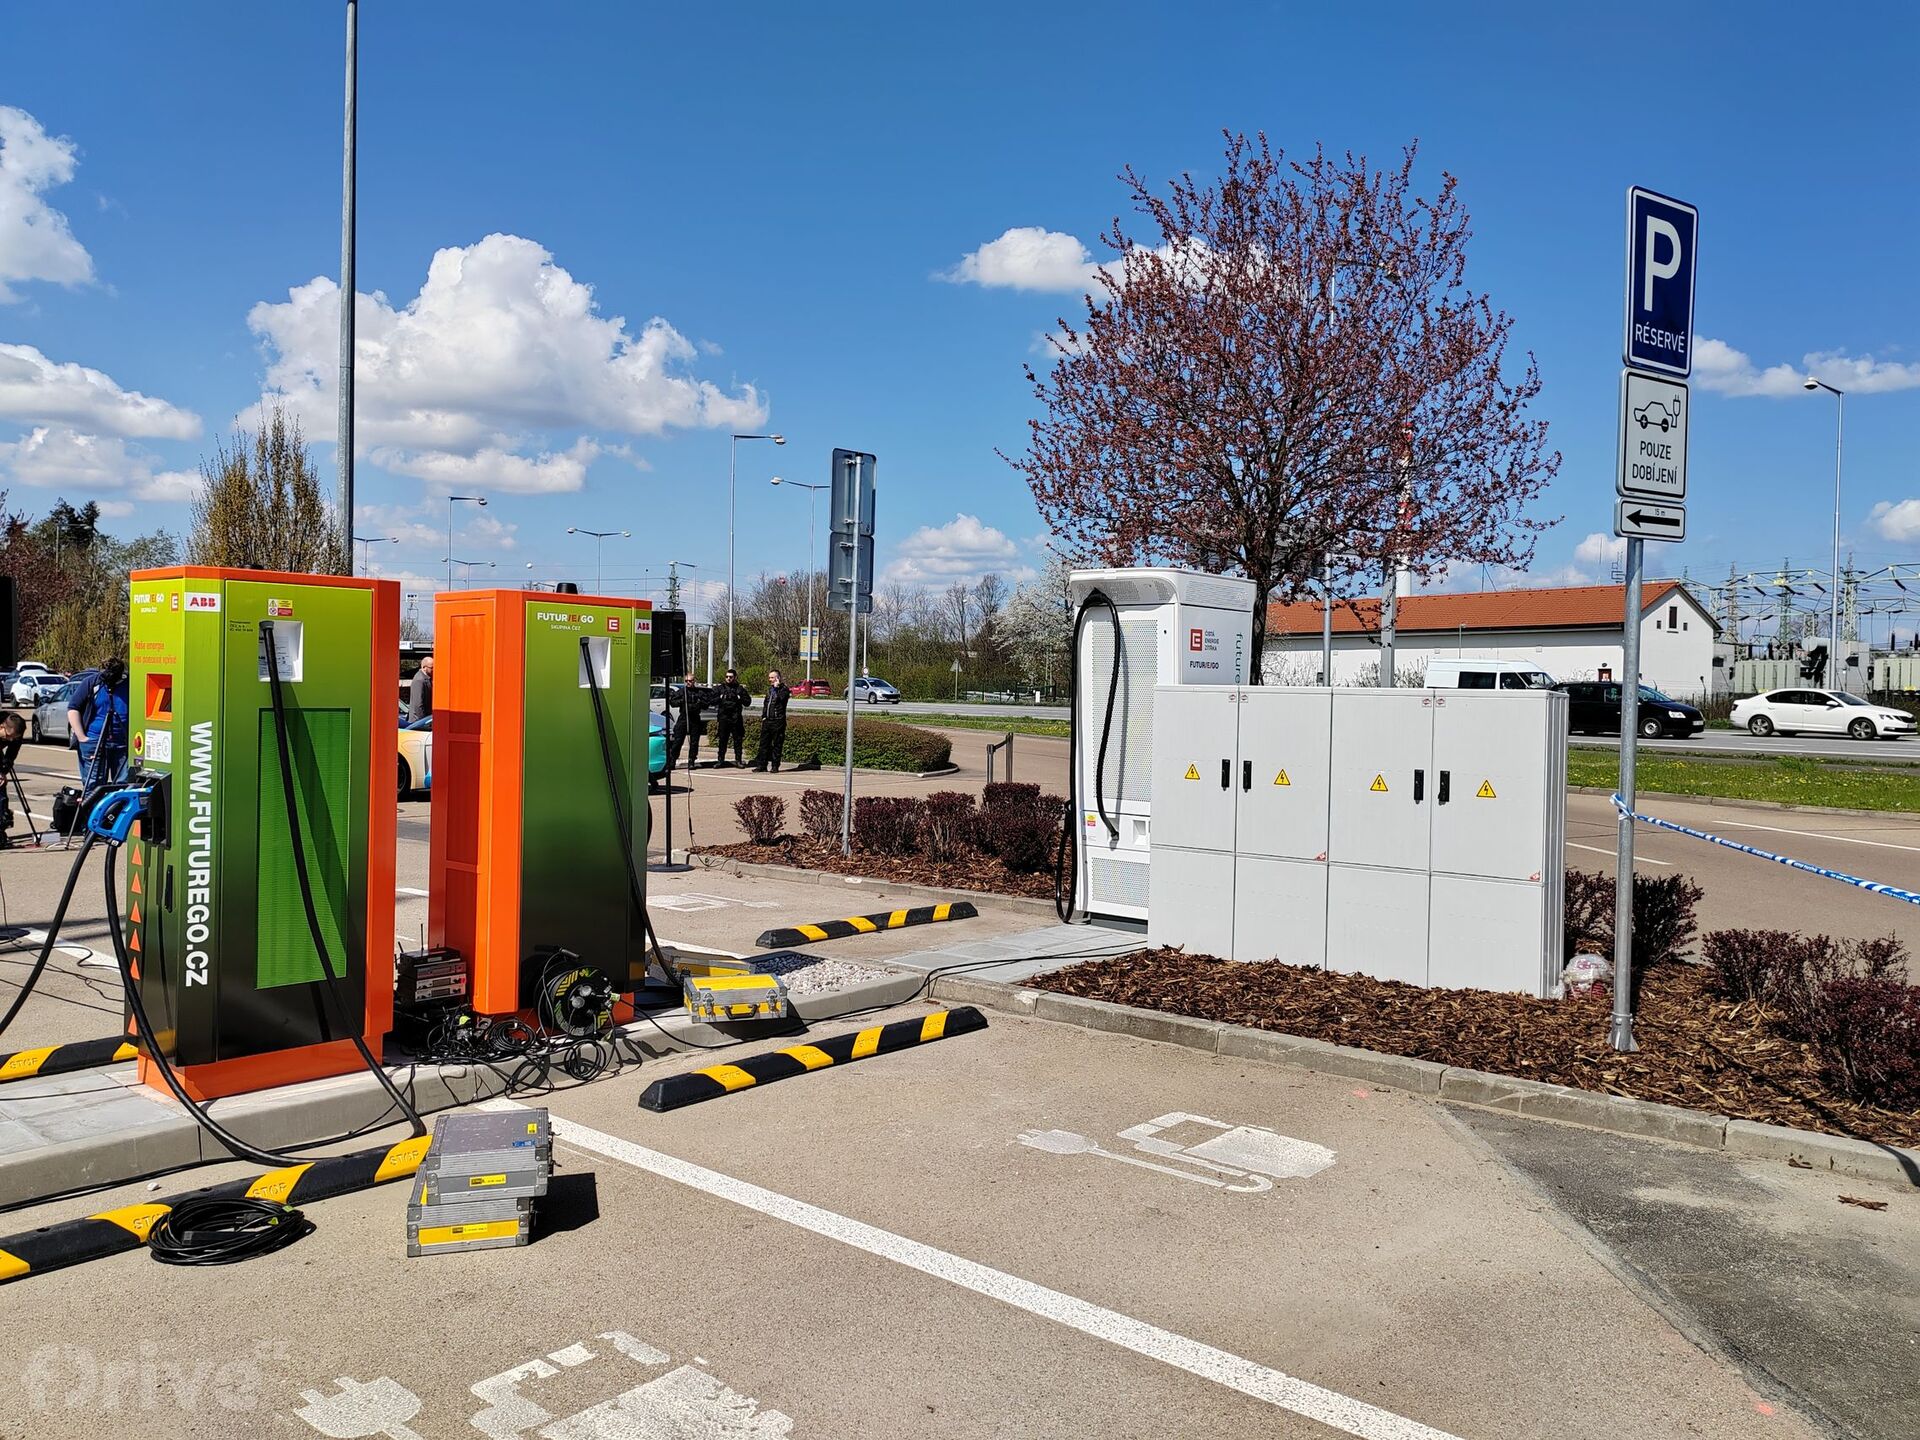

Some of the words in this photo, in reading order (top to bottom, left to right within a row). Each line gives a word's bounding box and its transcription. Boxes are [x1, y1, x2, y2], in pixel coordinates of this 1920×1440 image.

[1644, 215, 1682, 312] P
[1635, 322, 1686, 353] RÉSERVÉ
[1640, 441, 1672, 460] POUZE
[1632, 463, 1678, 485] DOBÍJENÍ
[190, 597, 216, 608] ABB
[637, 621, 650, 631] ABB
[184, 721, 213, 988] WWW.FUTUREGO.CZ
[390, 1150, 420, 1166] STOP
[253, 1182, 287, 1198] STOP
